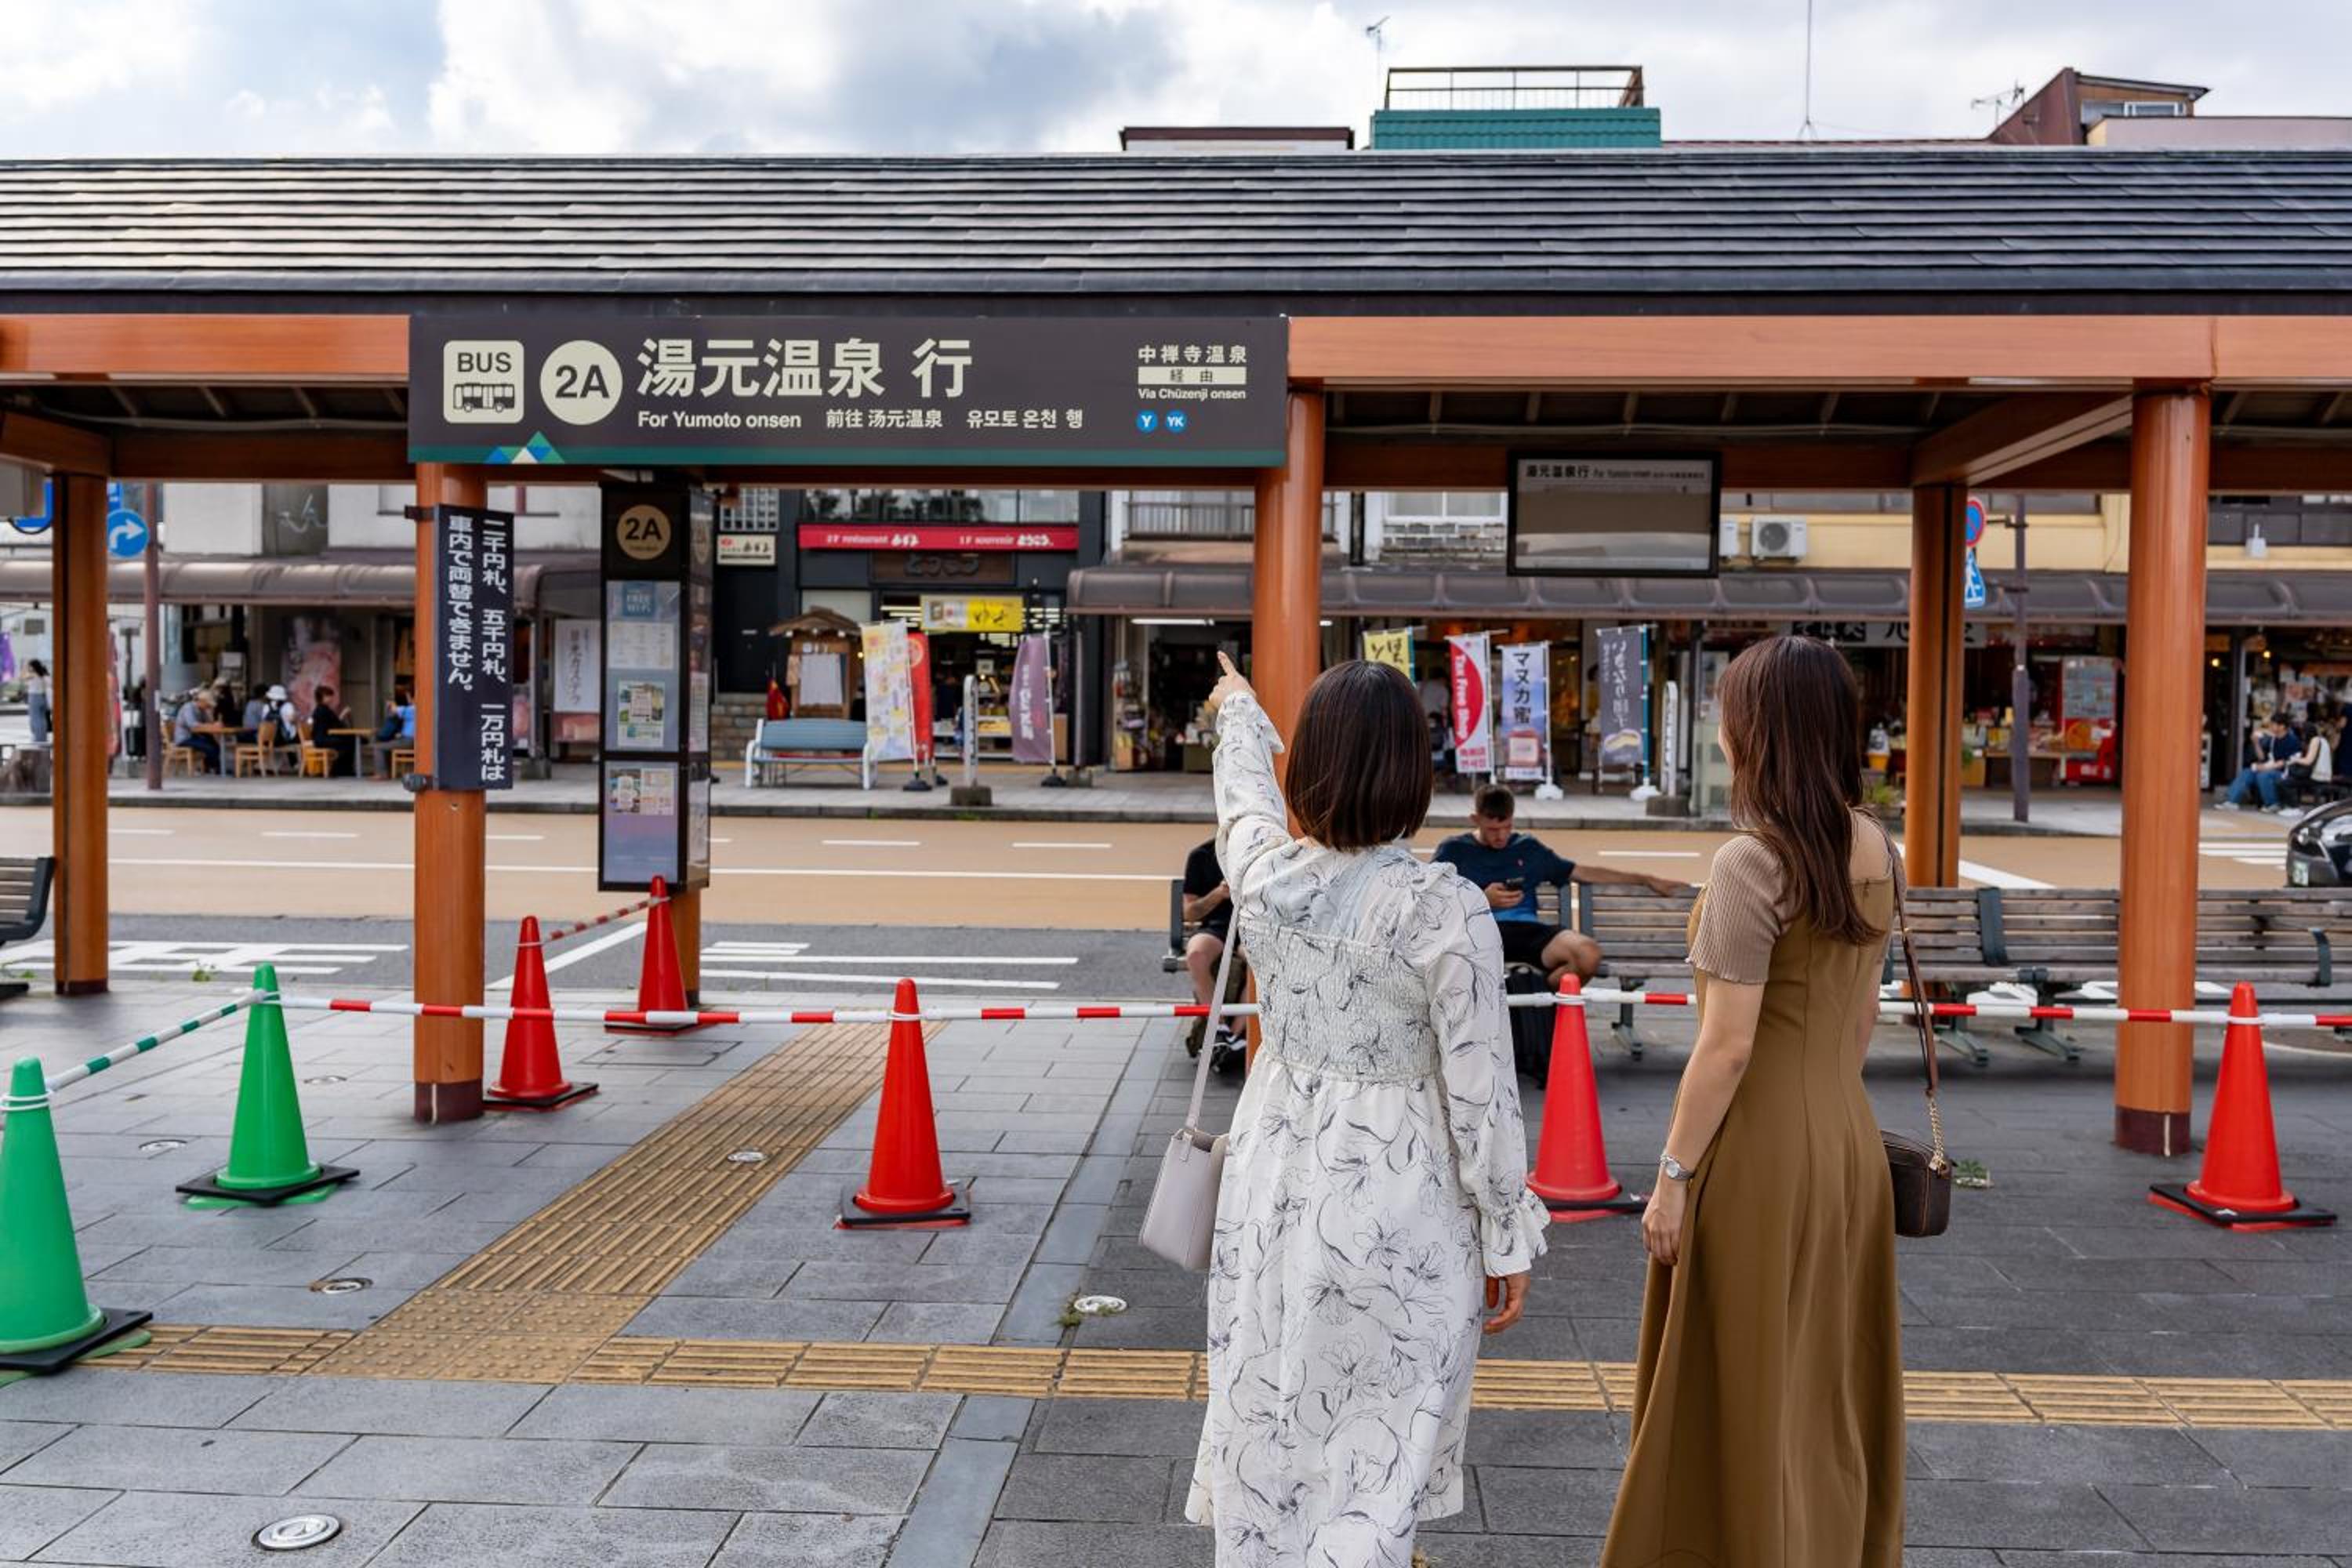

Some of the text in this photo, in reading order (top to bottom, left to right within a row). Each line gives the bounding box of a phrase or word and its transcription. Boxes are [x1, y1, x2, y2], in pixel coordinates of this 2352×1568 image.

[457, 351, 512, 373] BUS
[1138, 344, 1247, 365] 中禅寺温泉
[637, 337, 973, 398] 湯元温泉 行
[1170, 368, 1213, 383] 経由
[554, 364, 610, 399] 2A
[1138, 388, 1156, 399] Via
[1210, 390, 1247, 400] onsen
[638, 410, 802, 428] For Yumoto onsen
[826, 408, 943, 429] 前往 汤元温泉
[966, 408, 1083, 429] 유모토 온천 행
[1141, 415, 1152, 428] Y
[1167, 416, 1185, 427] YK
[625, 517, 662, 541] 2A
[447, 515, 474, 691] 車内で両替できません。
[481, 519, 506, 781] 二千円札、 五千円札、 一万円札は
[1513, 652, 1531, 724] マヌカ蜜
